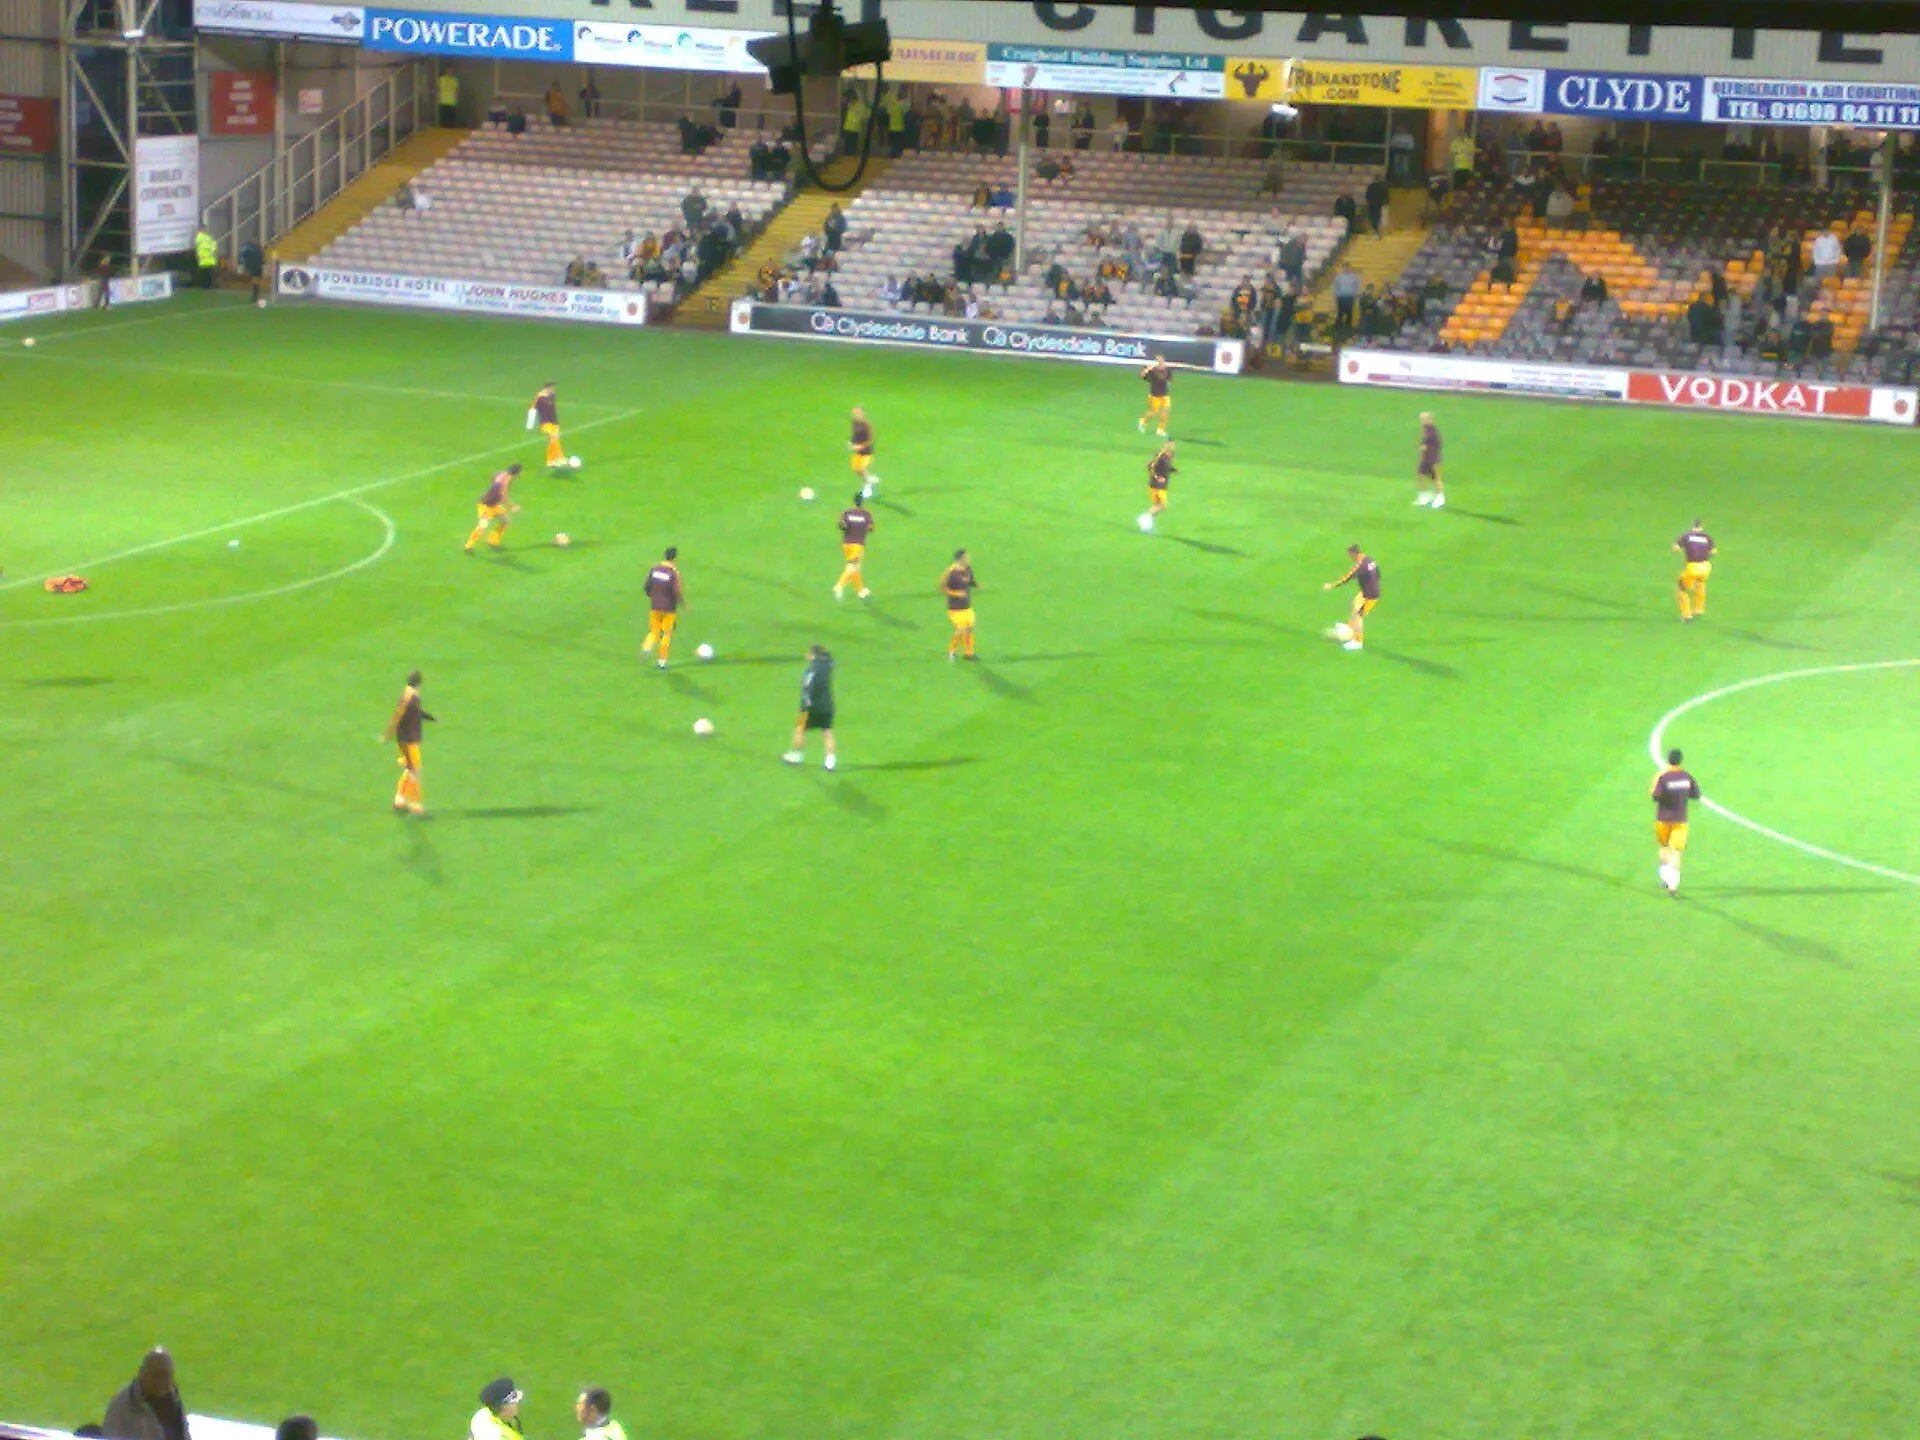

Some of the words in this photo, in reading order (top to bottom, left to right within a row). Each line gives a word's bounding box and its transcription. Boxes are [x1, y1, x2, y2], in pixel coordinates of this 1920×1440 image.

[372, 16, 562, 51] POWERADE
[1557, 76, 1692, 113] CLYDE
[929, 325, 969, 344] Bank
[1105, 338, 1146, 357] Bank
[1658, 374, 1837, 413] VODKAT
